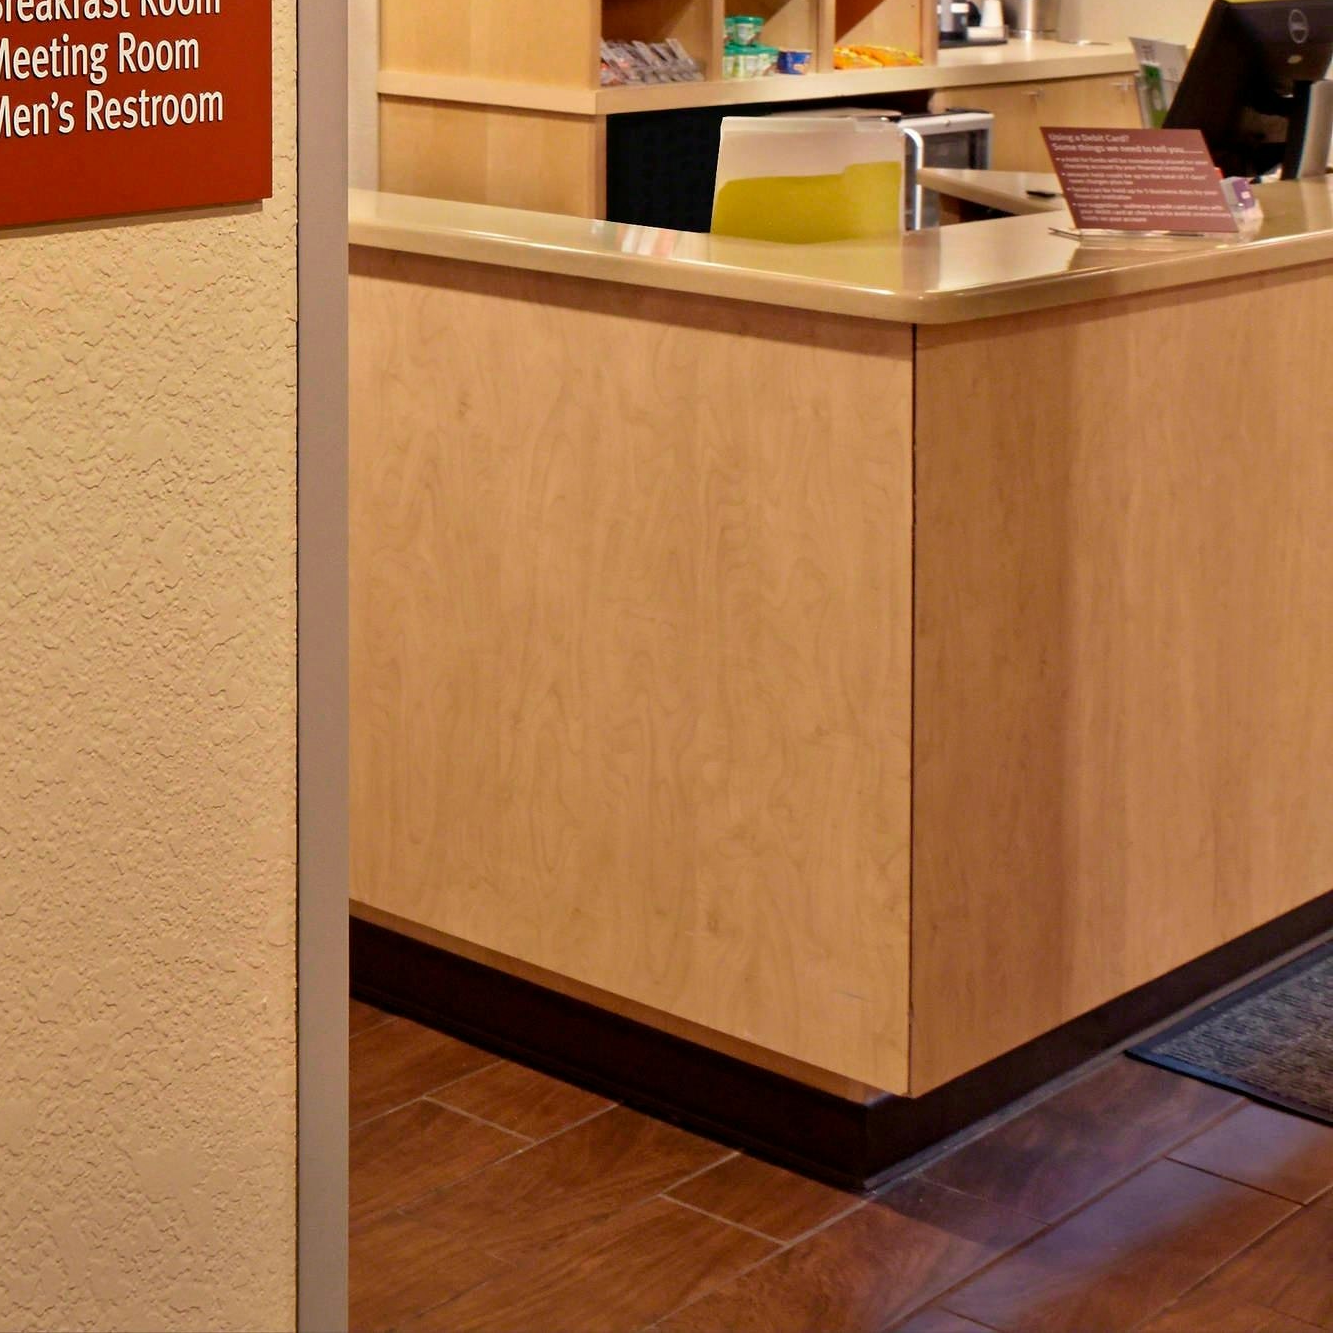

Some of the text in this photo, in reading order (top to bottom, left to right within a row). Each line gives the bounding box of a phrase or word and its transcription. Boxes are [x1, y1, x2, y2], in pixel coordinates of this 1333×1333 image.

[120, 33, 198, 72] Room
[87, 90, 222, 130] Restroom
[1081, 133, 1104, 142] Debit
